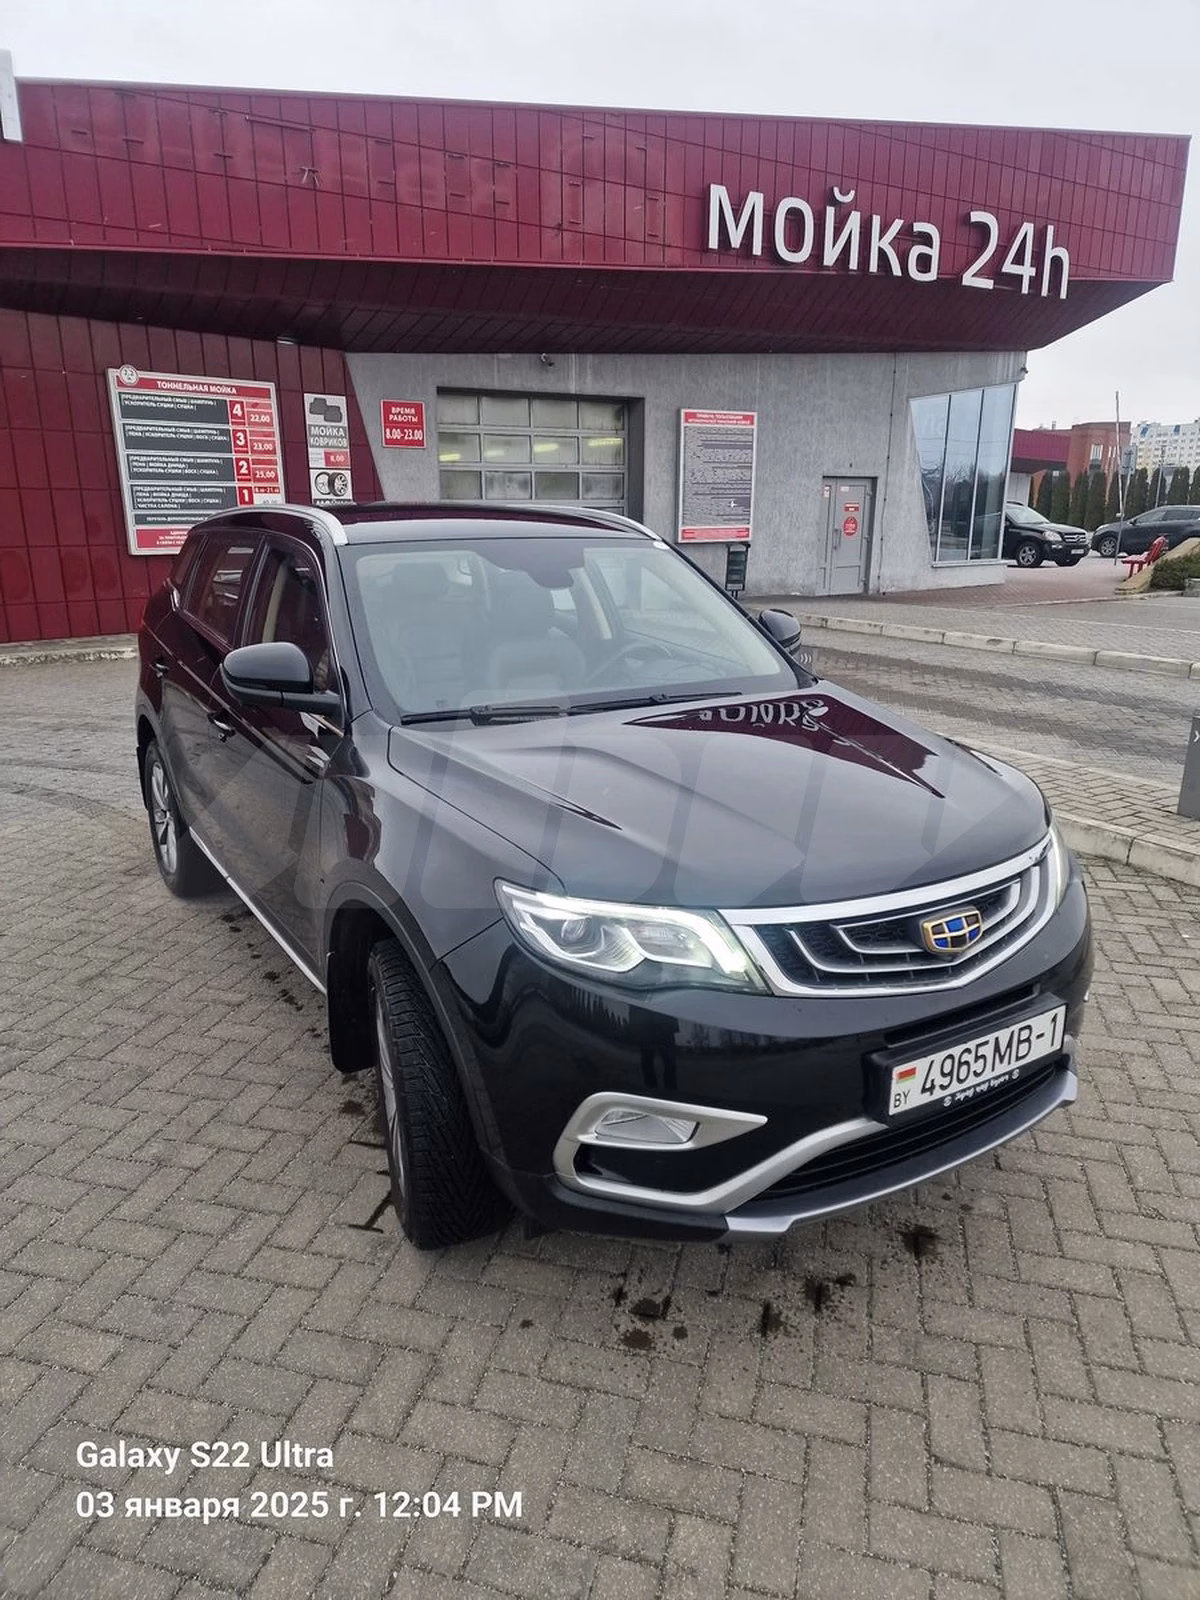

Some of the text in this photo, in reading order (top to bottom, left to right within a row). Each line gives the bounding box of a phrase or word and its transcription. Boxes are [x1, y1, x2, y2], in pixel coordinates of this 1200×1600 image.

[708, 183, 1071, 299] Мойка 24h
[156, 380, 237, 394] ТОННЕЛЬНАЯ МОЙКА
[232, 403, 243, 417] 4
[391, 406, 415, 414] ВРЕМЯ
[389, 414, 418, 422] РАБОТЫ
[235, 431, 246, 446] 3
[385, 428, 423, 440] 8.00-23.00
[310, 437, 348, 447] КОВРИКОВ
[238, 460, 249, 474] 2
[242, 488, 250, 502] 1
[920, 1012, 1060, 1097] 4965MB-1
[893, 1090, 910, 1108] BY
